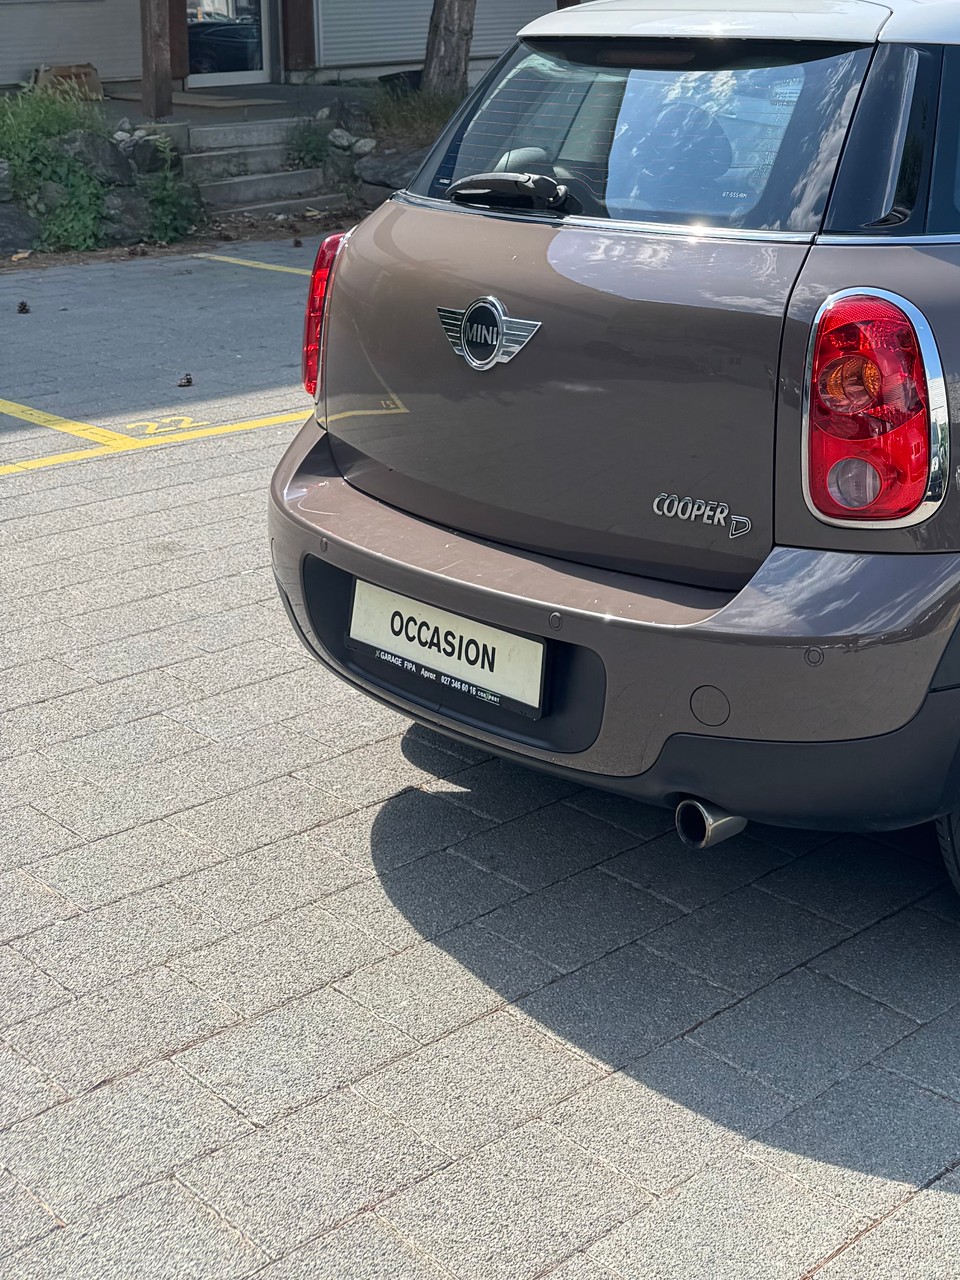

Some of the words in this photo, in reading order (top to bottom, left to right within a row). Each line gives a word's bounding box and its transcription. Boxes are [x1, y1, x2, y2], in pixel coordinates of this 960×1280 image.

[465, 322, 497, 345] MINI
[126, 416, 211, 434] 22
[652, 492, 729, 527] COOPER
[729, 515, 752, 539] D
[390, 610, 497, 673] OCCASION
[380, 651, 402, 667] GARAGE
[404, 661, 416, 673] FIPA
[421, 668, 437, 680] Aproz
[441, 675, 451, 686] 027
